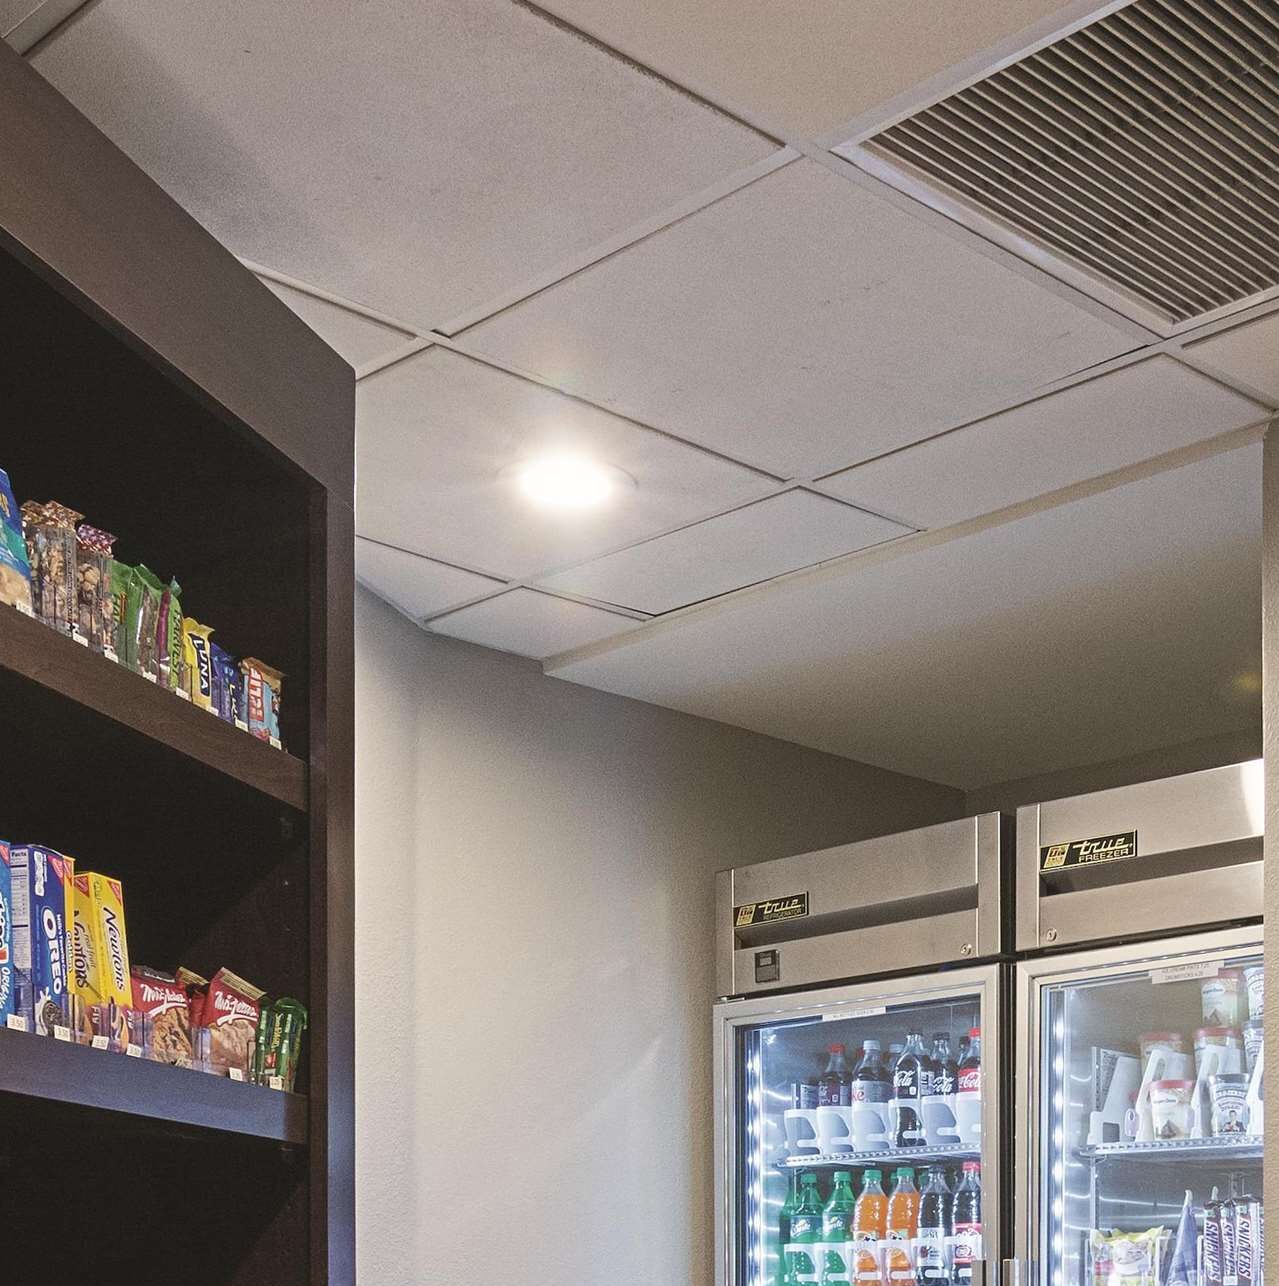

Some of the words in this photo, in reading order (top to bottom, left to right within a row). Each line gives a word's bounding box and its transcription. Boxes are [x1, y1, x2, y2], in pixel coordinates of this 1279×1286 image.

[193, 638, 209, 690] LUNA
[1072, 837, 1129, 856] true
[1078, 848, 1129, 863] FREEZER
[758, 899, 801, 914] true
[42, 907, 63, 995] OREO
[103, 907, 125, 992] Newtons
[1238, 1218, 1251, 1277] SNICKERS
